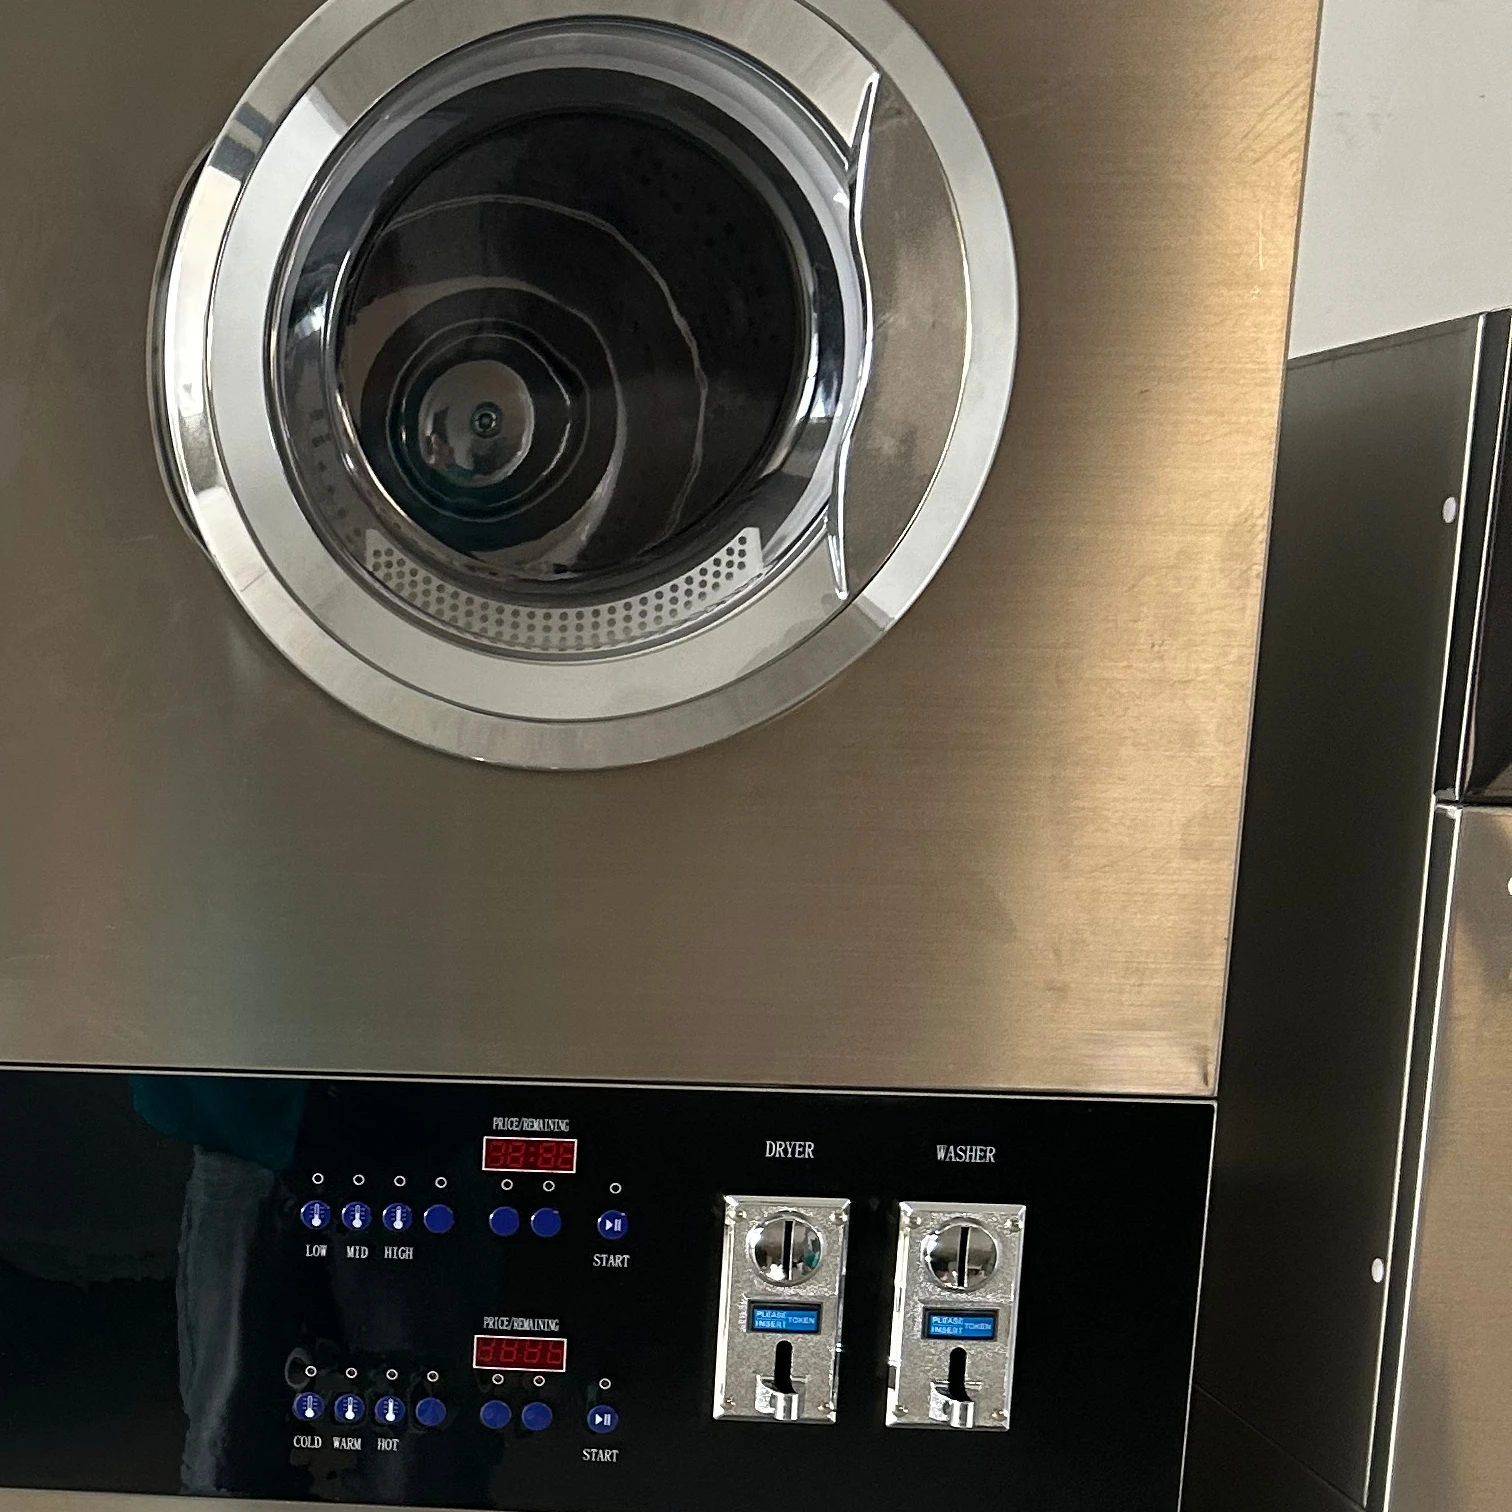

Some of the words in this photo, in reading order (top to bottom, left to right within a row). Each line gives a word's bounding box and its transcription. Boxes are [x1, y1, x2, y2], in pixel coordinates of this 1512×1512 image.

[492, 1117, 570, 1132] PRICE/REMAINING
[765, 1140, 815, 1159] DRYER
[936, 1145, 996, 1163] WASHER
[305, 1245, 328, 1258] LOW
[346, 1246, 369, 1259] MID
[384, 1246, 414, 1260] HIGH
[593, 1254, 630, 1268] START
[483, 1316, 560, 1332] PRICE/REMAINING
[293, 1436, 322, 1449] COLD
[333, 1437, 362, 1451] WARM
[377, 1438, 399, 1451] HOT
[582, 1448, 619, 1463] START
